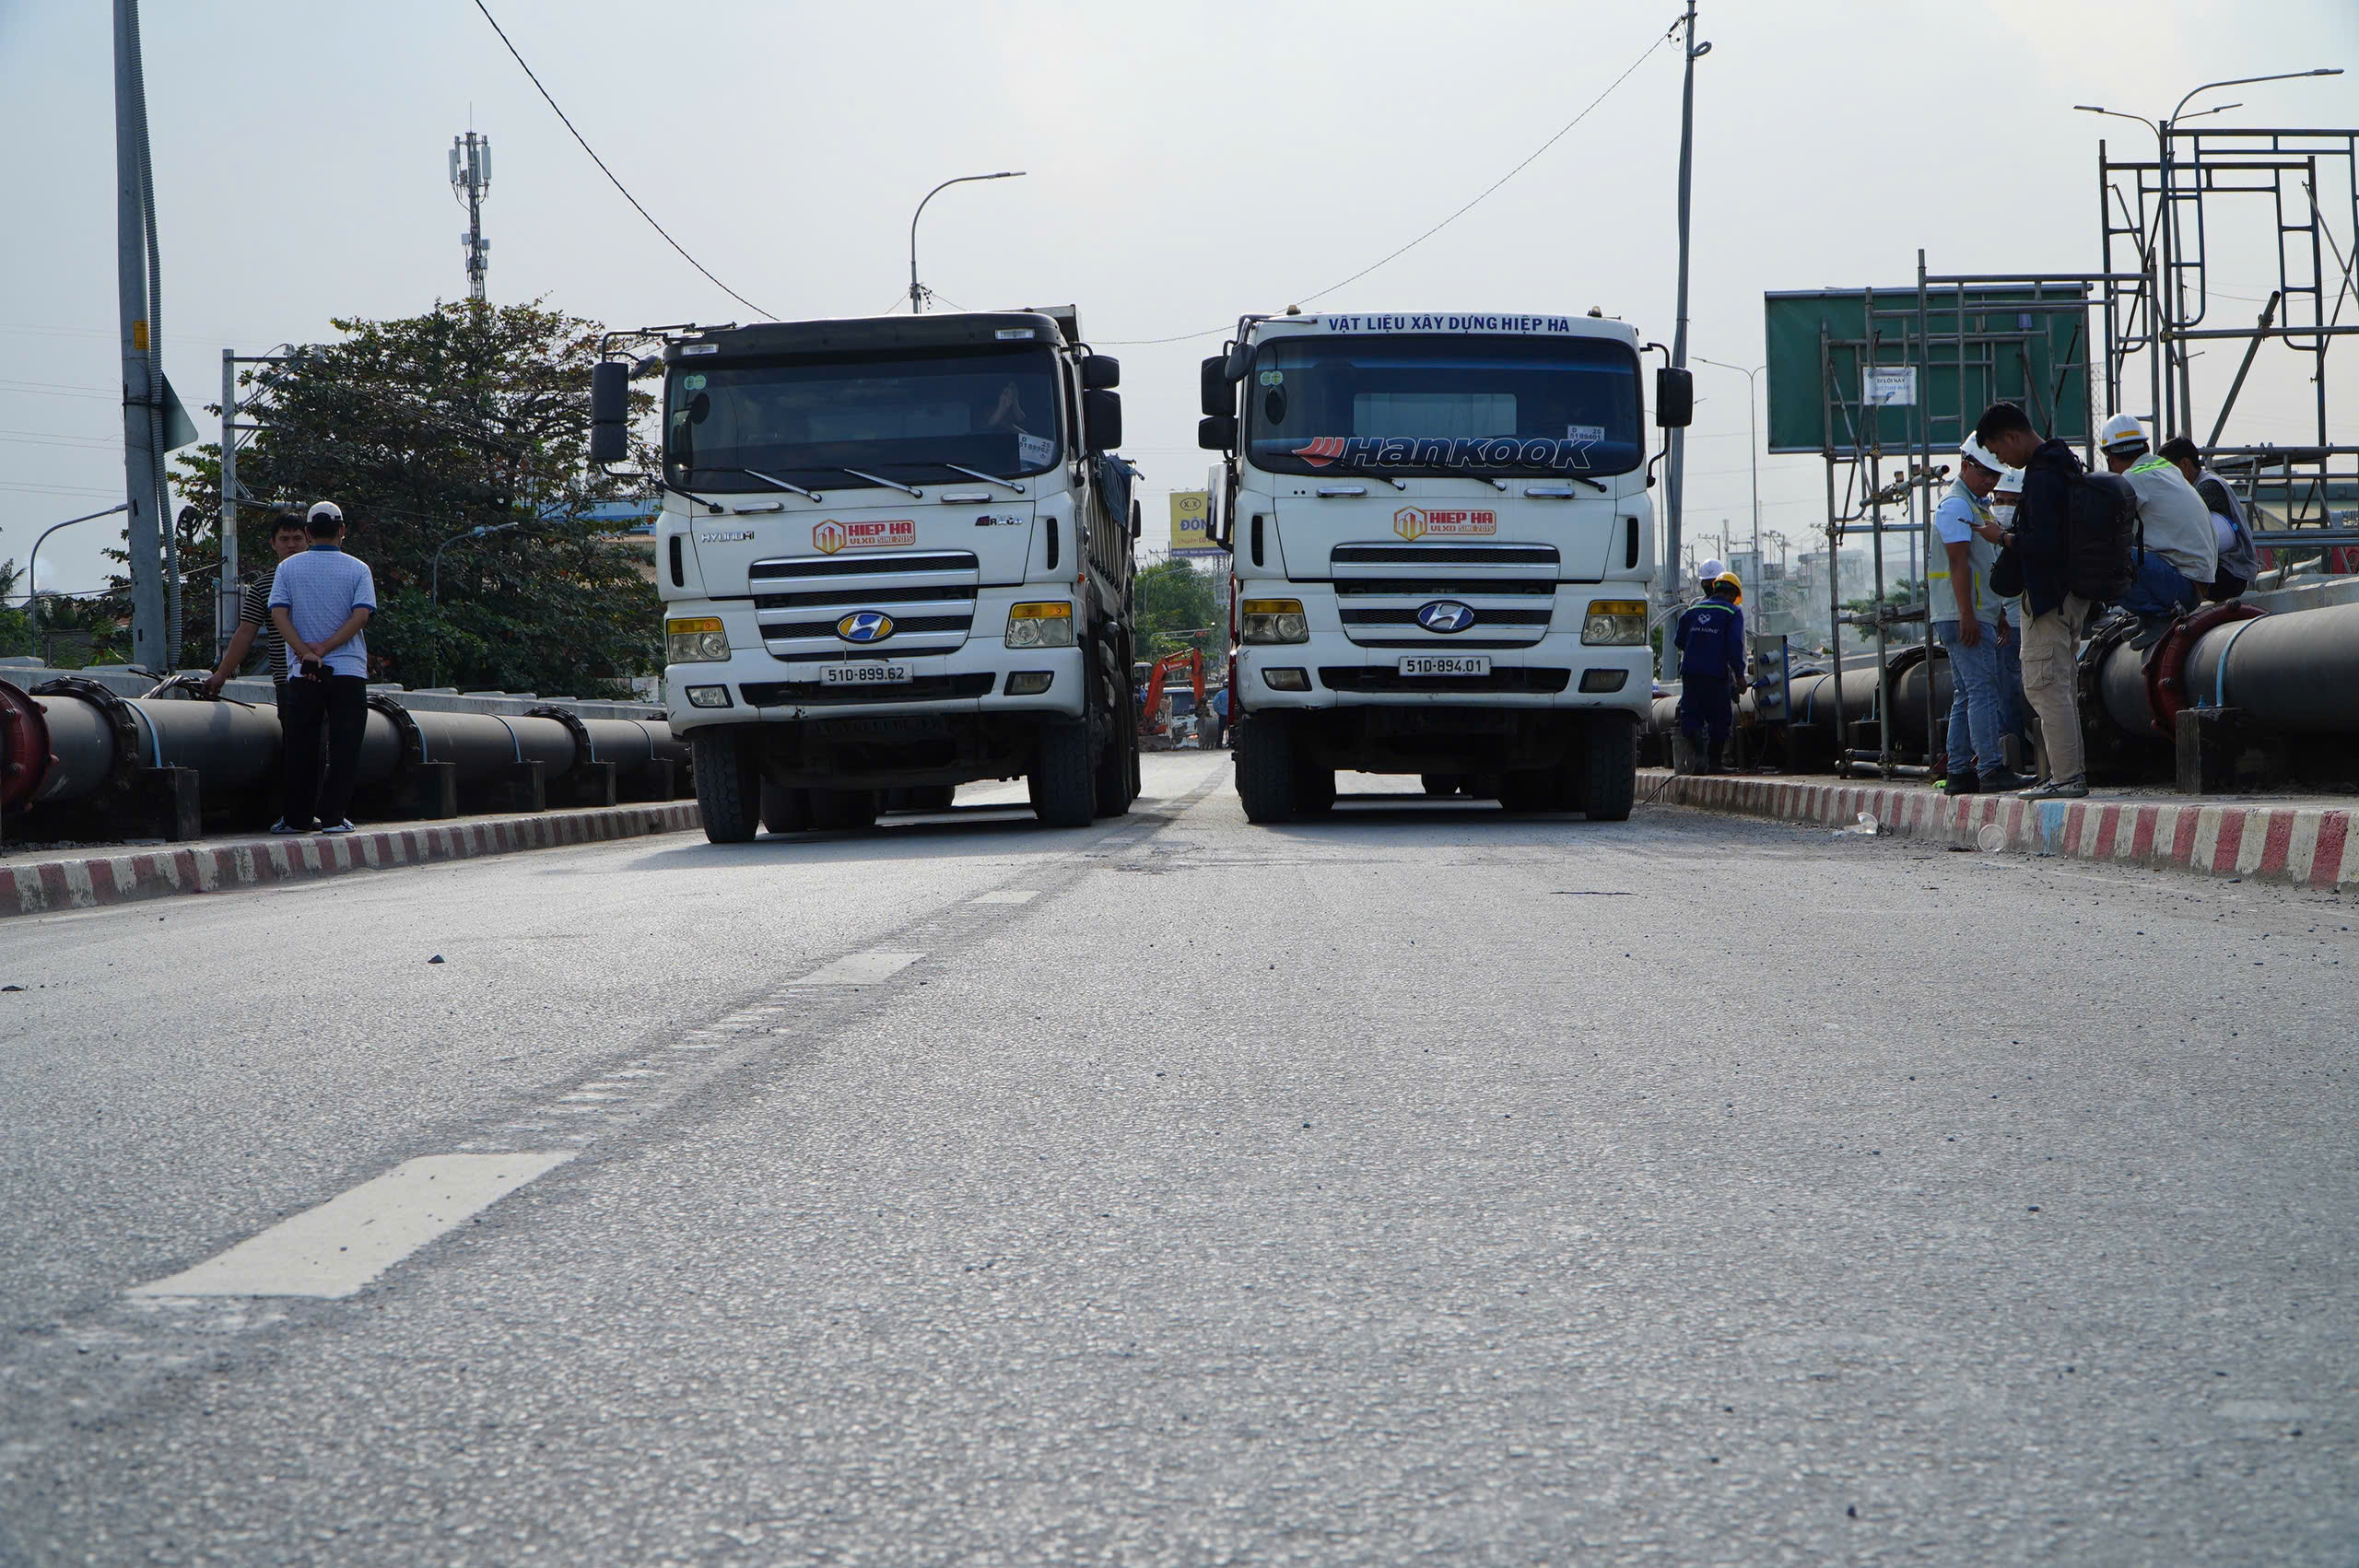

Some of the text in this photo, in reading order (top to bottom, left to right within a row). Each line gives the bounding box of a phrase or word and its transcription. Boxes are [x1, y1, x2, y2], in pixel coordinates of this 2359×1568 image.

[1328, 313, 1570, 334] VẬT LIỆU XÂY DỰNG HIỆP HÀ
[1429, 512, 1494, 524] HIEP HA
[848, 522, 912, 537] HIEP HA
[1407, 660, 1481, 673] 51D-894.01
[828, 667, 905, 682] 51D-899.62
